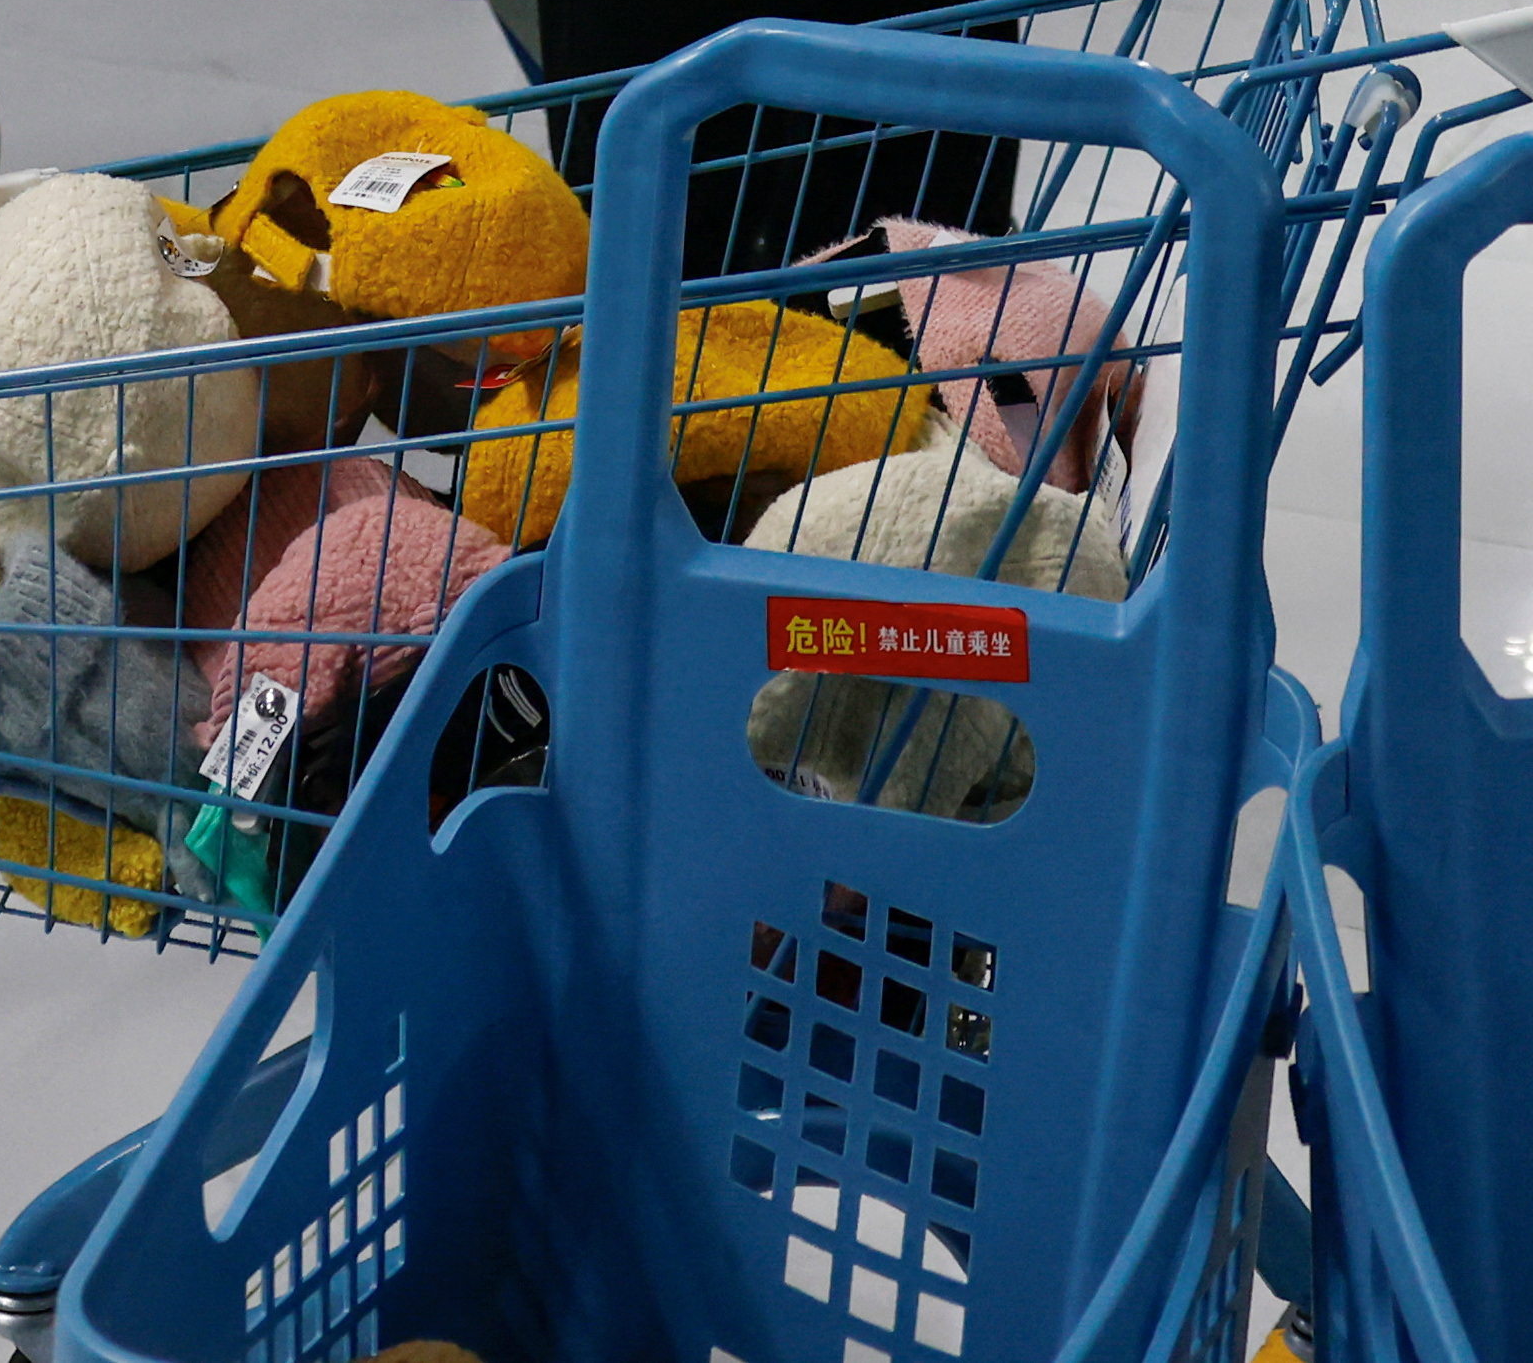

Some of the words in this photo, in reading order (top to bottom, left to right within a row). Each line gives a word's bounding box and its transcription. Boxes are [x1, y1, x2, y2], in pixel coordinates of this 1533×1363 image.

[786, 615, 867, 655] 危险!
[878, 626, 1012, 657] 禁止儿童乘坐
